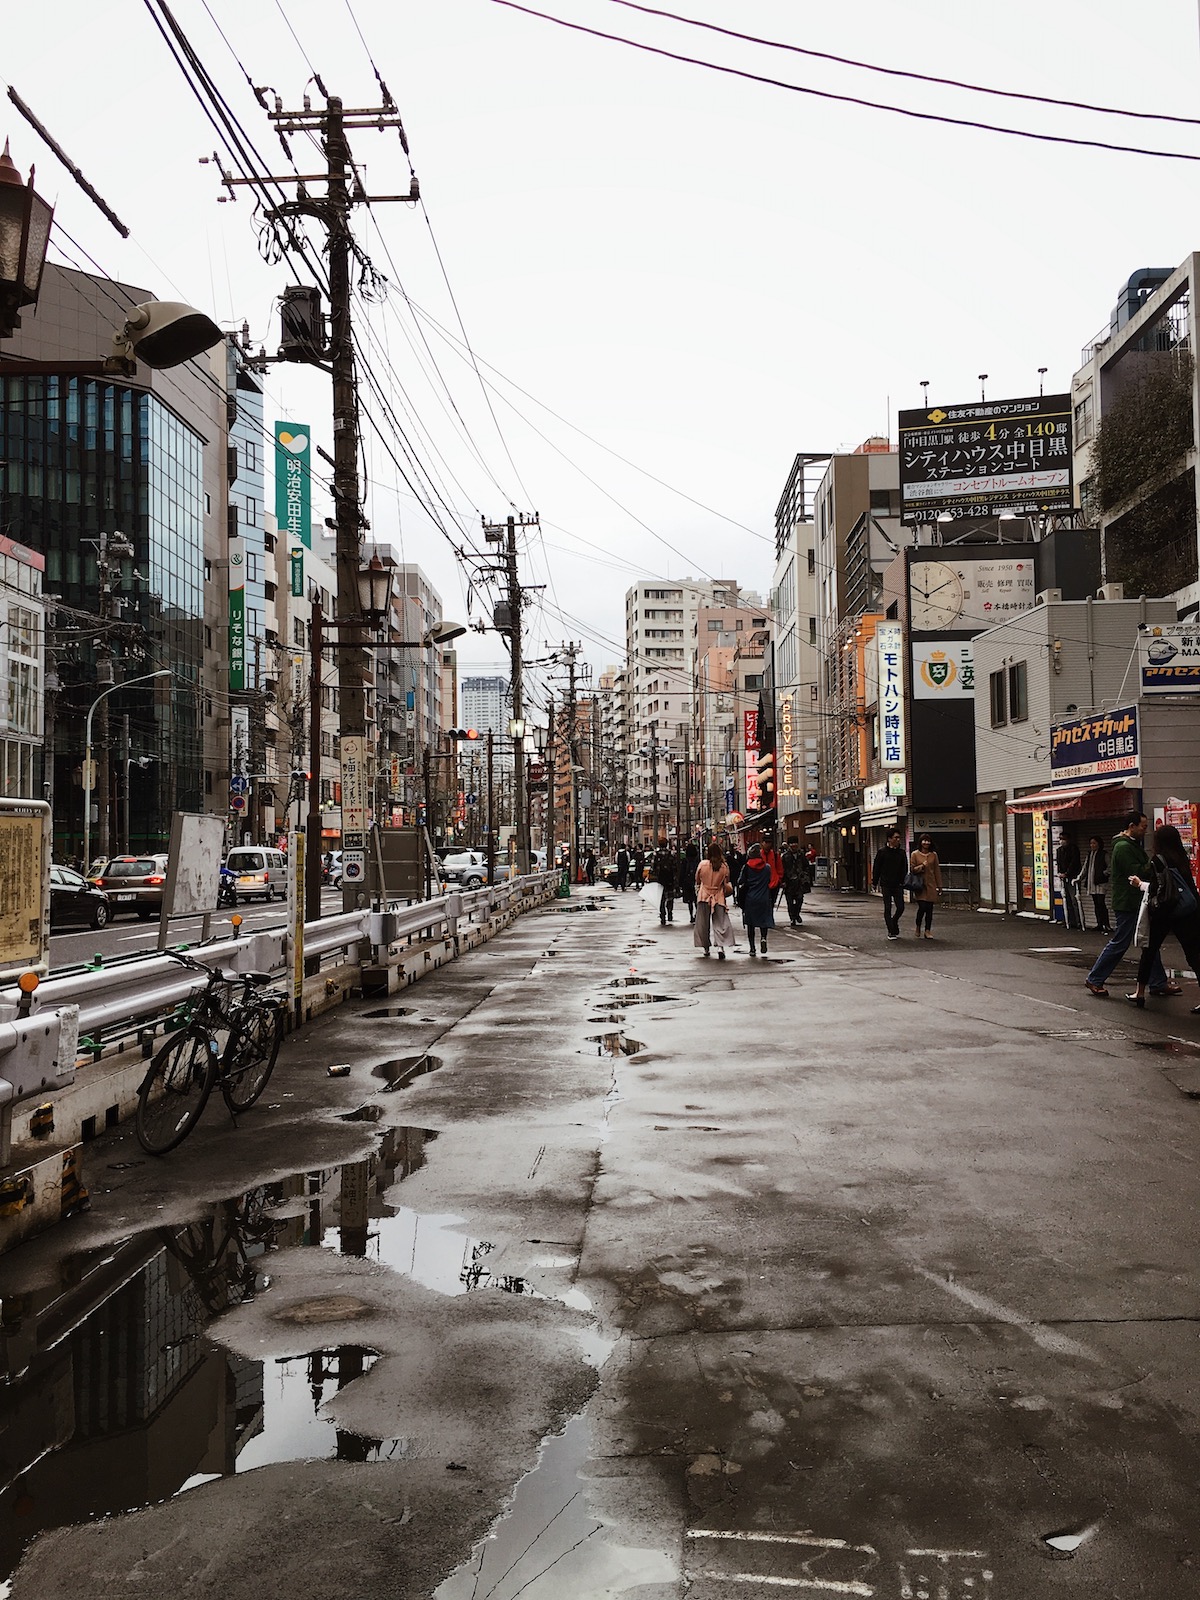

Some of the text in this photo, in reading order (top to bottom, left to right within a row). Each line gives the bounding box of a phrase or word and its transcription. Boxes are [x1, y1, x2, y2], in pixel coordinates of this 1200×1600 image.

[947, 402, 1040, 419] 住友不動産のマンション
[957, 431, 981, 444] 徒歩
[984, 423, 1010, 441] 4分
[1014, 422, 1068, 438] 全140邸
[904, 436, 1068, 468] シティハウス中目黒
[926, 457, 1041, 480] ステーションコート
[953, 472, 1067, 492] コンセプトルームオープン
[232, 610, 243, 671] りそな銀行
[884, 652, 901, 761] モトハシ時計店
[1052, 714, 1135, 748] アクセスチケット
[782, 704, 793, 784] PROVENCE
[1097, 735, 1134, 757] 中目黒店
[1096, 759, 1117, 772] ACCESS
[1117, 756, 1136, 770] TICKET
[348, 756, 356, 807] 七田チャイルド
[777, 787, 801, 796] cafe
